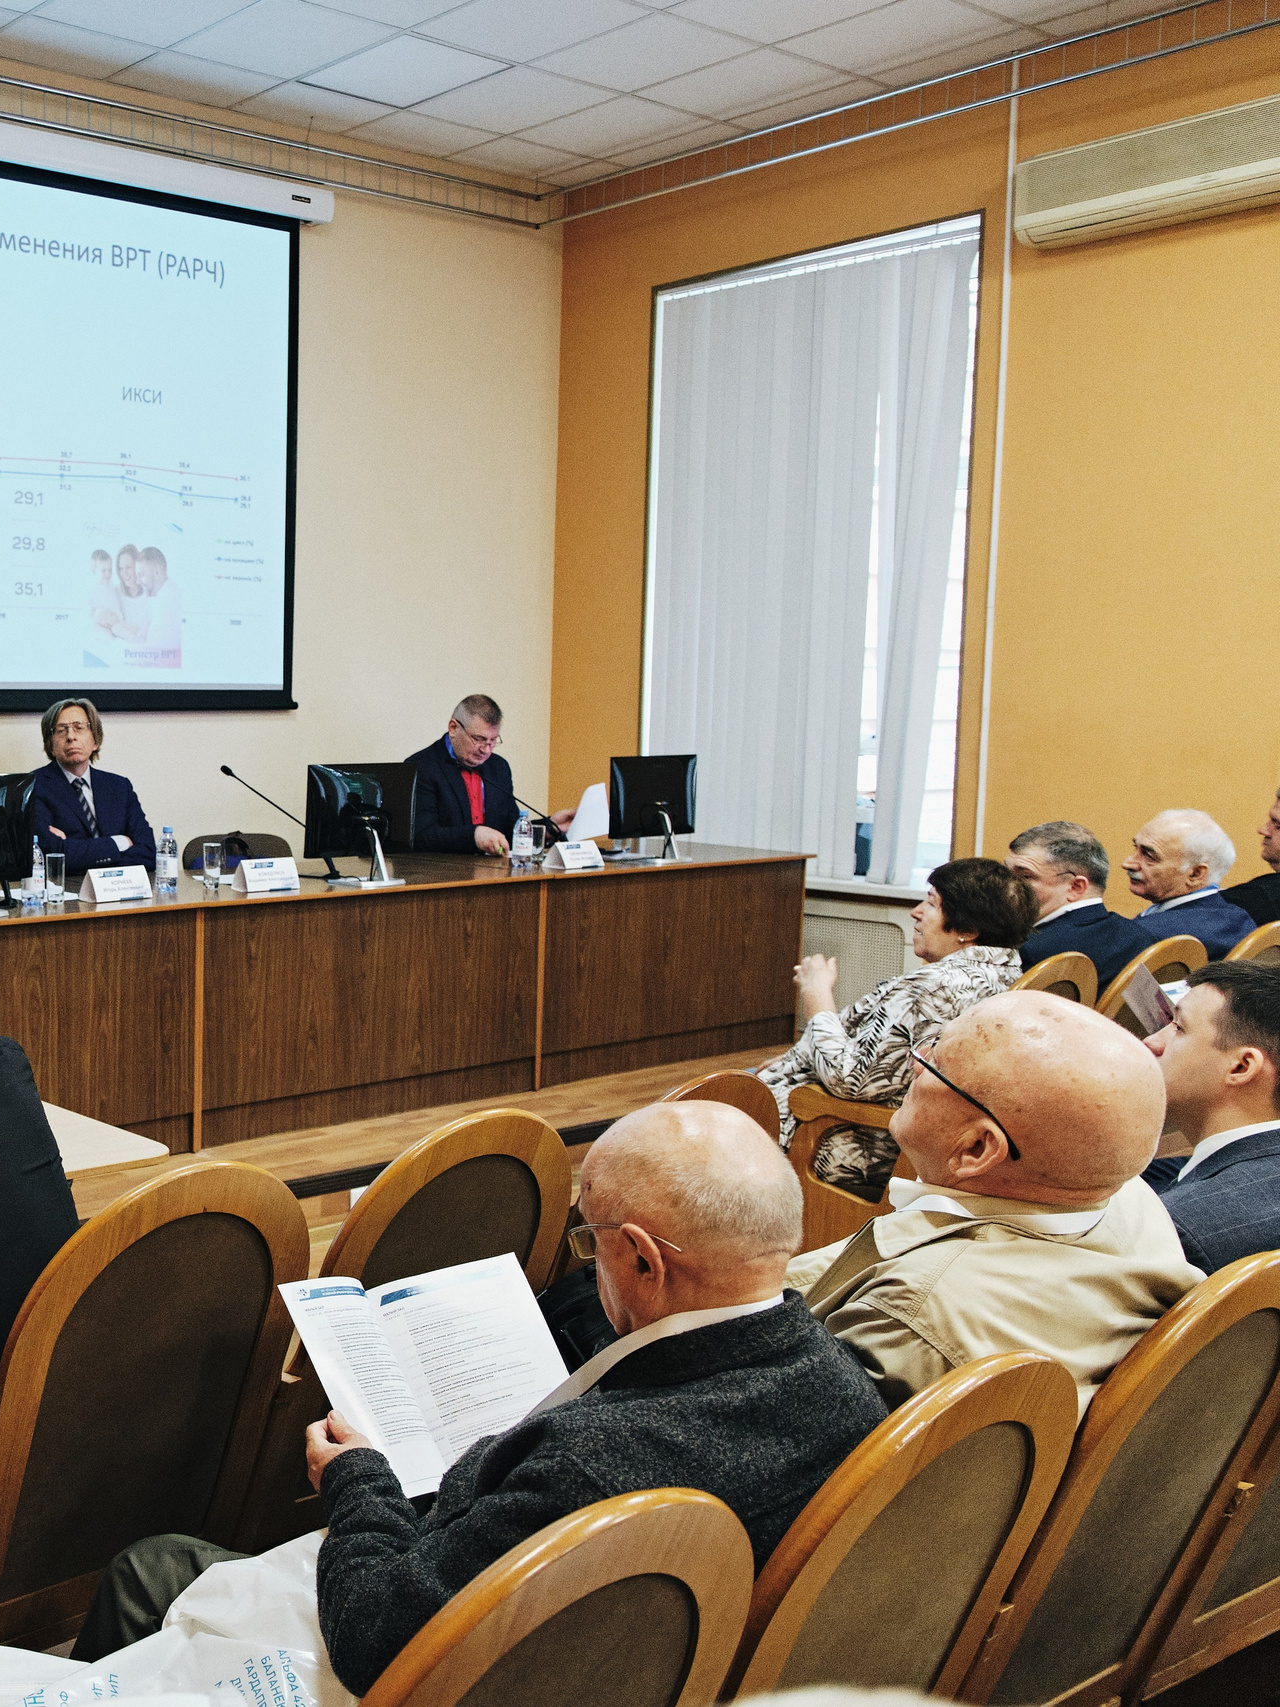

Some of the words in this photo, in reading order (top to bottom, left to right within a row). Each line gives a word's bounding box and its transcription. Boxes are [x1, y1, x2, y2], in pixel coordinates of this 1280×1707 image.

[111, 245, 151, 271] ВРТ
[158, 251, 225, 289] (РАРЧ)
[122, 386, 162, 405] ИКСИ
[14, 491, 44, 507] 29,1
[12, 536, 45, 552] 29,8
[14, 582, 44, 597] 35,1
[124, 649, 159, 660] Регистр
[277, 1650, 299, 1692] АЛЬФА
